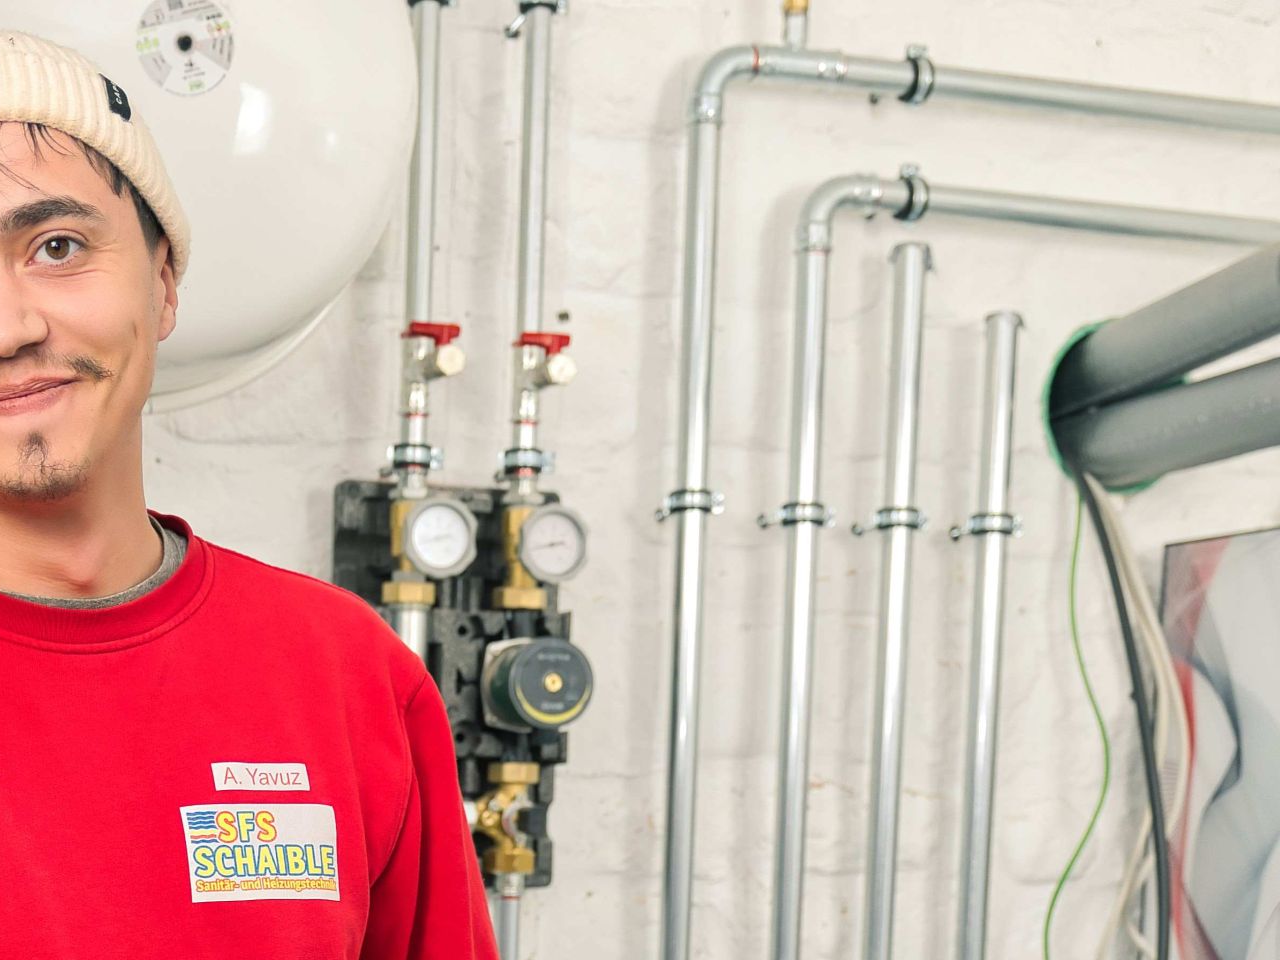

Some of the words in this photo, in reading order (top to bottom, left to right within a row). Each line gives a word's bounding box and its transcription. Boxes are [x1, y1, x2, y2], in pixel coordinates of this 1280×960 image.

[223, 767, 242, 785] A.
[246, 768, 302, 785] Yavuz
[216, 811, 277, 843] SFS
[193, 844, 336, 878] SCHAIBLE
[241, 878, 262, 890] und
[263, 878, 336, 892] Heizungstechnik
